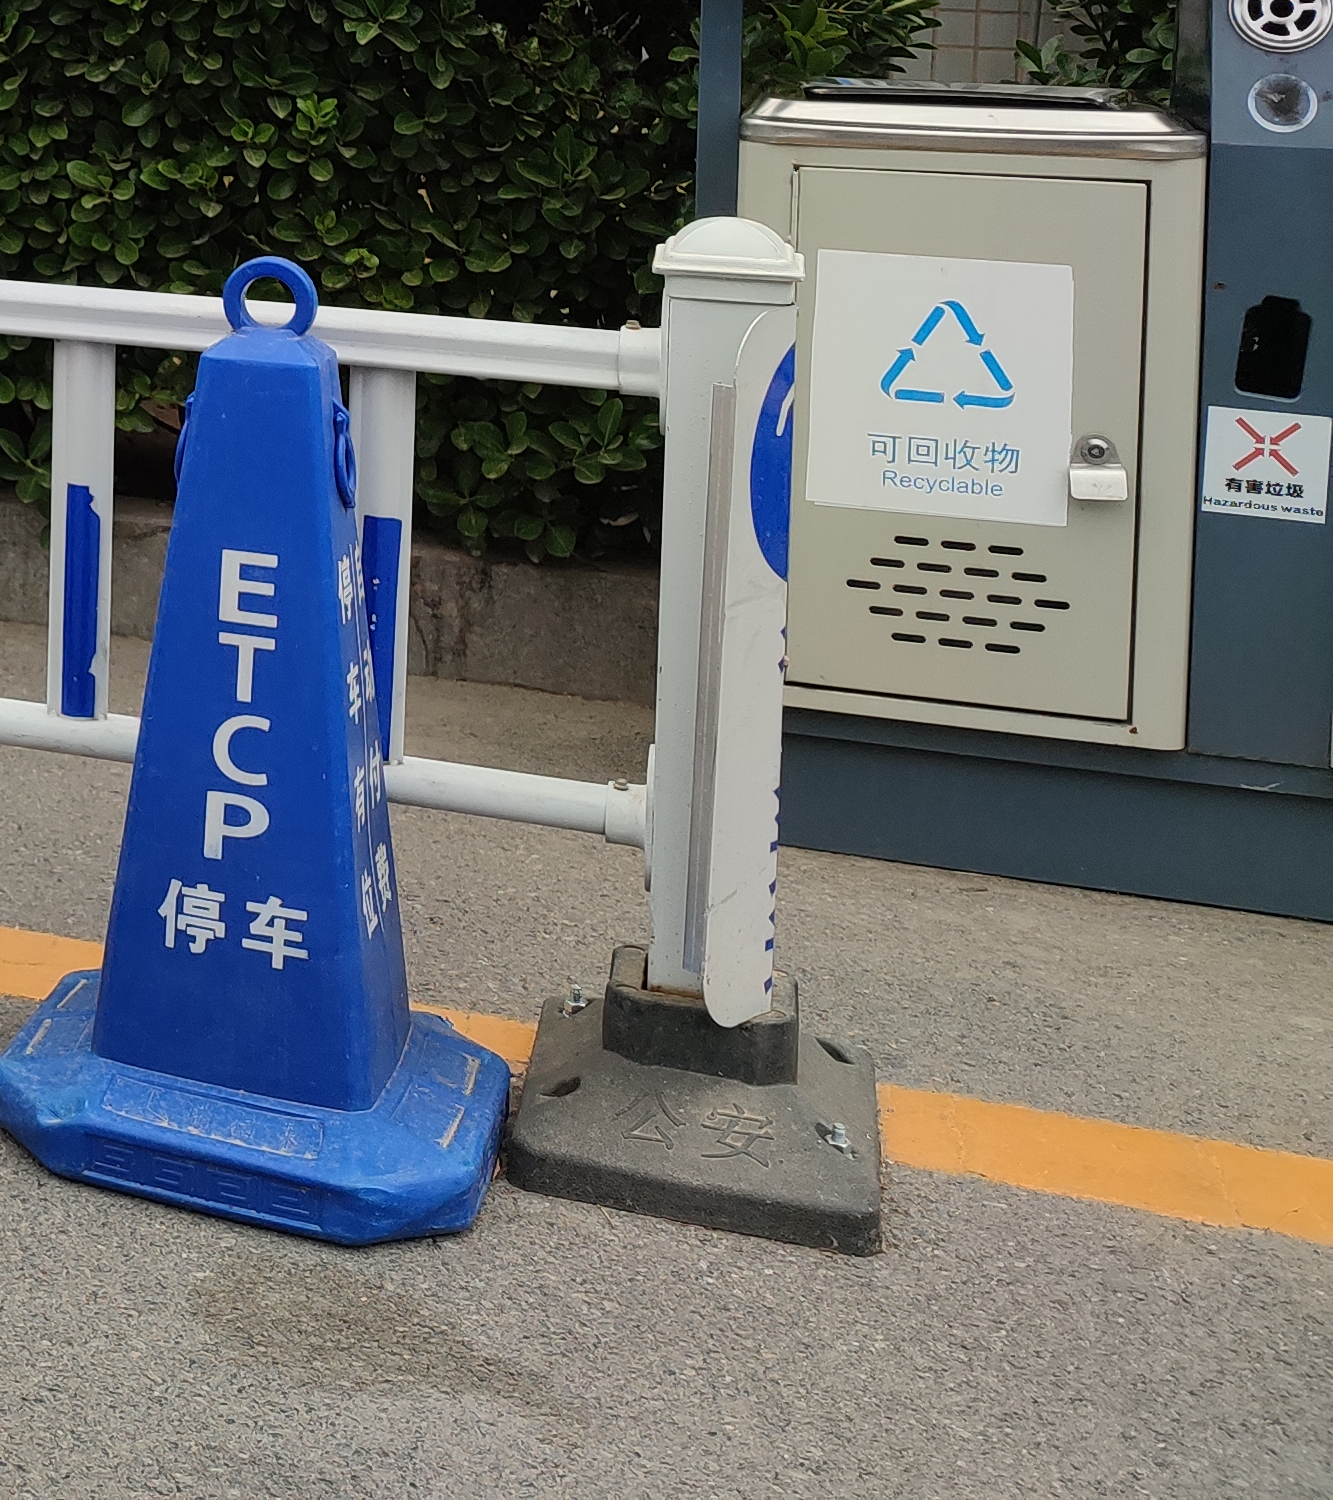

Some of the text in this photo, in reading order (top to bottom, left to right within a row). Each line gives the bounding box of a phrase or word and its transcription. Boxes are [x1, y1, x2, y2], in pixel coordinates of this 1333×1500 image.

[866, 432, 1022, 475] 可回收物
[881, 468, 1005, 498] Recyclable
[1225, 477, 1305, 499] 有害垃圾
[1203, 495, 1324, 517] Hazardous waste
[202, 548, 279, 861] ETCP
[157, 877, 311, 972] 停车
[614, 1091, 776, 1168] 公安
